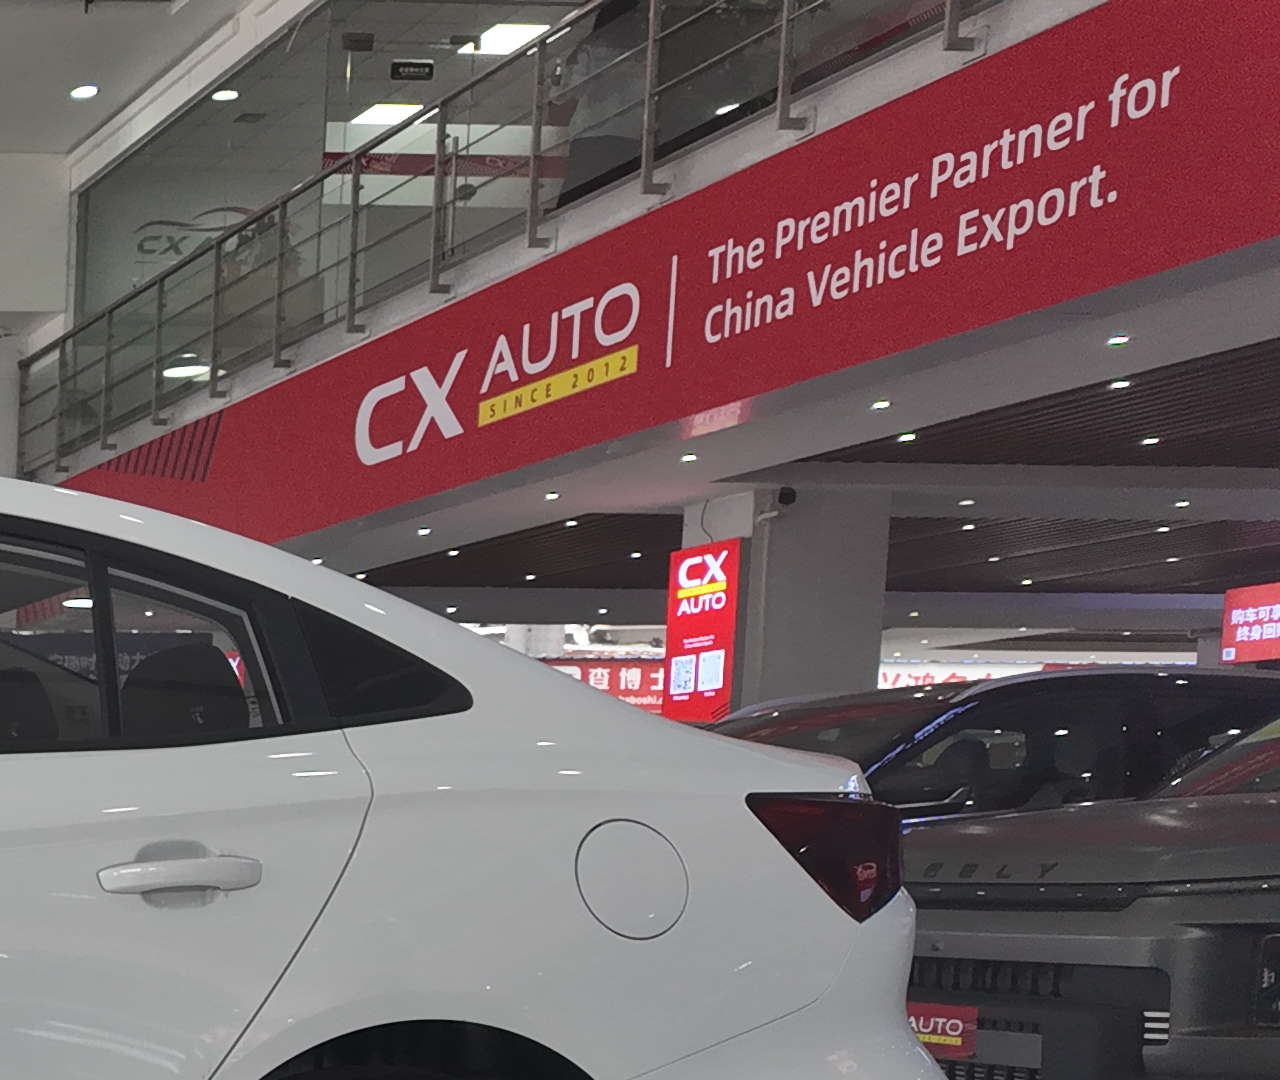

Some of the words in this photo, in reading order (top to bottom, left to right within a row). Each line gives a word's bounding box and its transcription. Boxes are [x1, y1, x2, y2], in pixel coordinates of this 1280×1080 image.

[708, 238, 765, 283] The
[775, 172, 919, 259] Premier
[930, 99, 1096, 198] Partner
[1109, 65, 1180, 128] for
[704, 286, 794, 343] China
[807, 229, 943, 308] Vehicle
[957, 165, 1117, 256] Export.
[355, 349, 468, 465] CX
[480, 282, 640, 394] AUTO
[489, 383, 552, 418] SINCE
[572, 355, 627, 388] 2012
[678, 550, 728, 588] CX
[677, 592, 726, 616] AUTO
[923, 862, 1058, 879] EELY
[909, 1016, 963, 1035] AUTO
